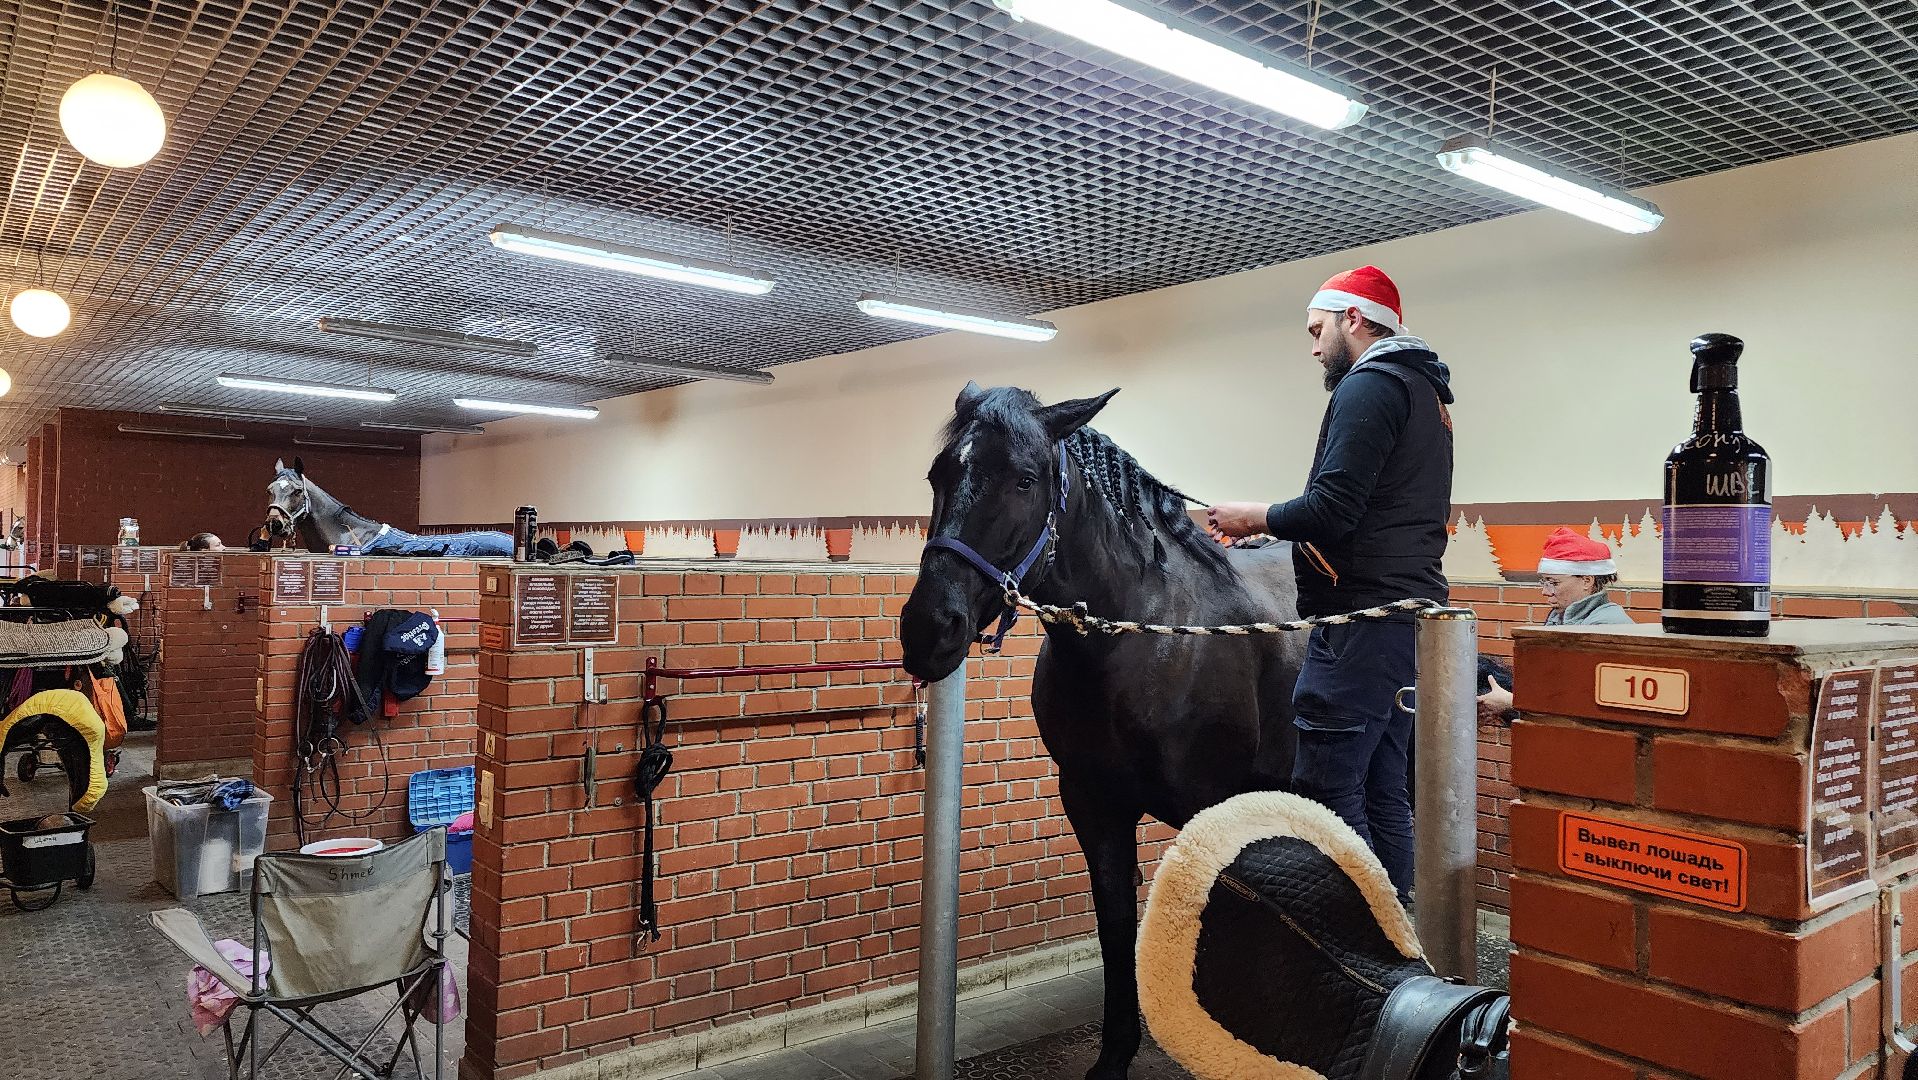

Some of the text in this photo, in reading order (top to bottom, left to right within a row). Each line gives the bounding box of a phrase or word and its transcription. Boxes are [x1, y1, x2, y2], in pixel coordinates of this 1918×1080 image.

[1624, 675, 1659, 701] 10
[1577, 827, 1725, 872] Вывел лошадь
[1584, 852, 1673, 881] выключи
[1677, 871, 1729, 893] свет!
